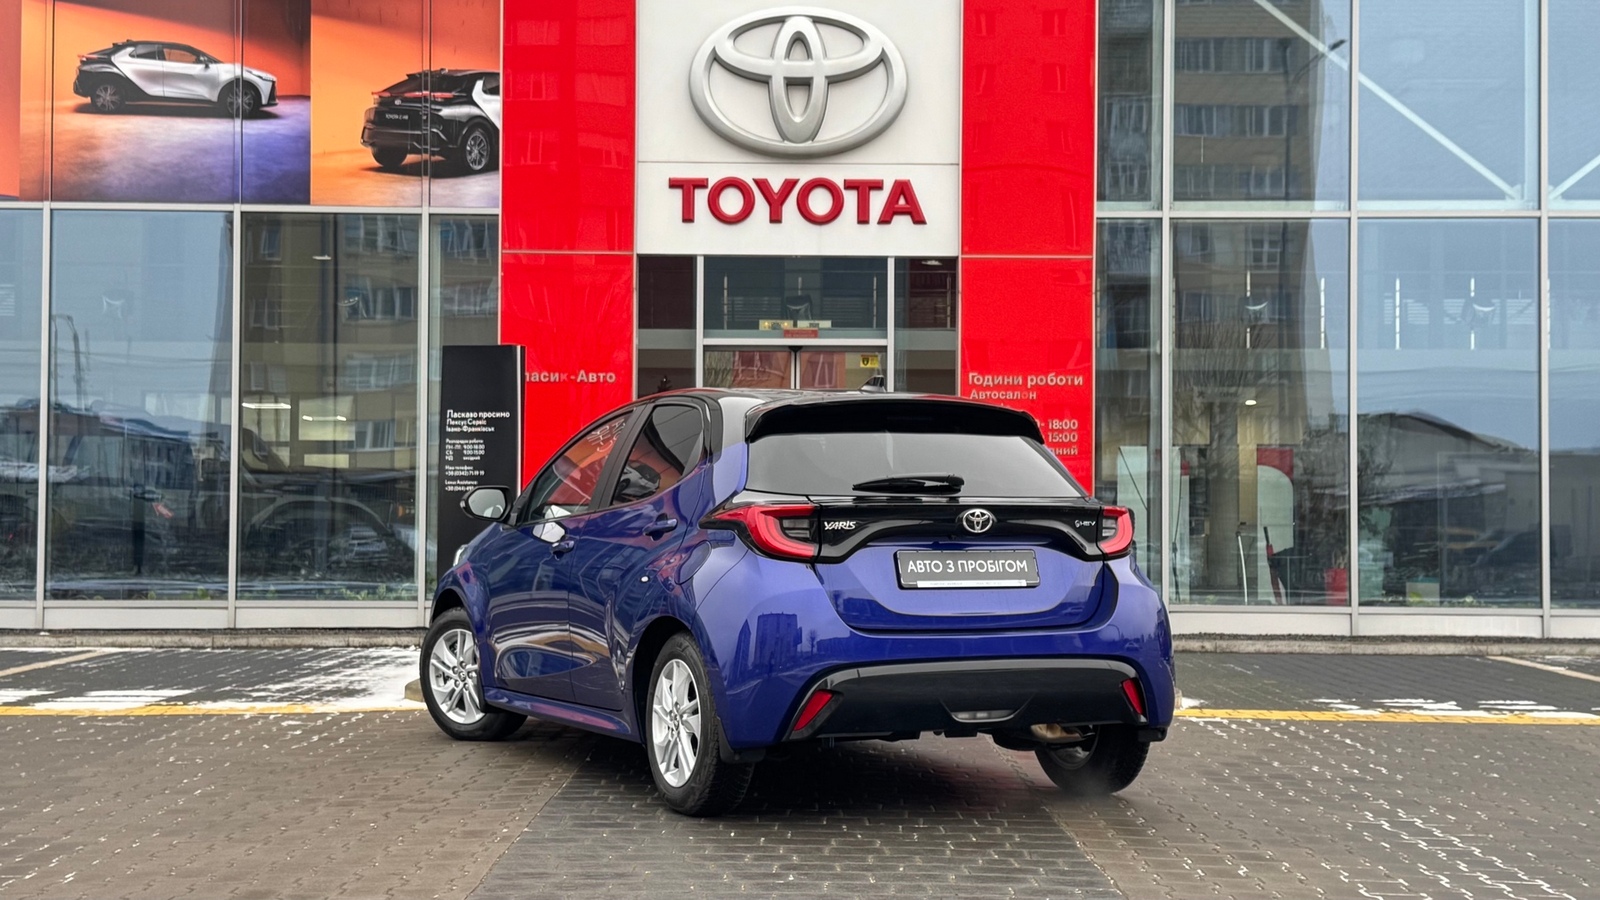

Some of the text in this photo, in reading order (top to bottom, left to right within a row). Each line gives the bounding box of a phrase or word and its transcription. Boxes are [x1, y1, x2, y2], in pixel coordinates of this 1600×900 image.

[668, 176, 927, 225] TOYOTA
[968, 372, 1083, 388] Години роботи
[970, 389, 1036, 400] Автосалон
[1048, 419, 1079, 430] 18:00
[1048, 432, 1079, 443] 15:00
[824, 521, 856, 530] YARIS
[907, 560, 943, 573] АВТО
[958, 560, 1028, 573] ПРОБІГОМ
